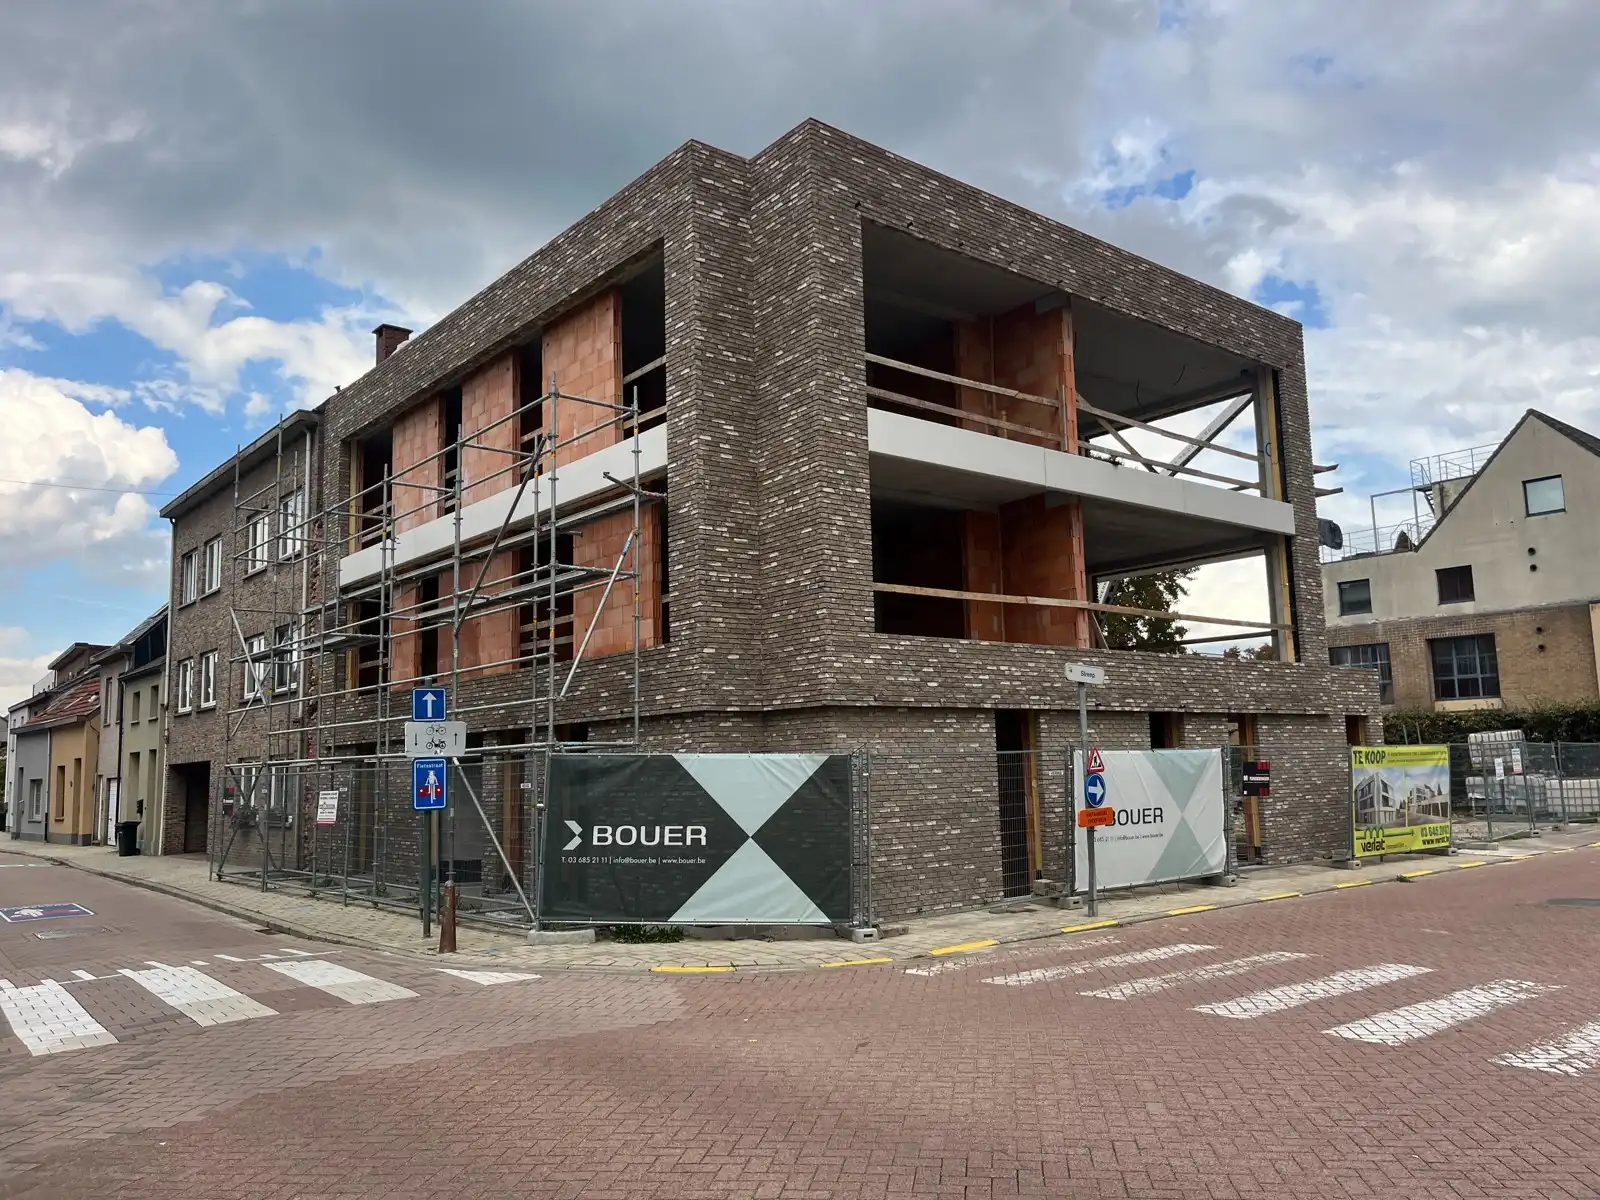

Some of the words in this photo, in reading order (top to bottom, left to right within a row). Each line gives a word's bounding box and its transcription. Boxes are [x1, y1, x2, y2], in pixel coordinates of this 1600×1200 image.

[1353, 750, 1364, 765] TE
[1365, 750, 1386, 765] KOOP
[592, 825, 707, 846] BOUER
[567, 856, 577, 864] 03
[578, 856, 591, 864] 685
[591, 856, 599, 864] 21
[601, 856, 608, 864] 11
[613, 856, 657, 864] info@bouer.be
[662, 856, 706, 864] www.bouer.be
